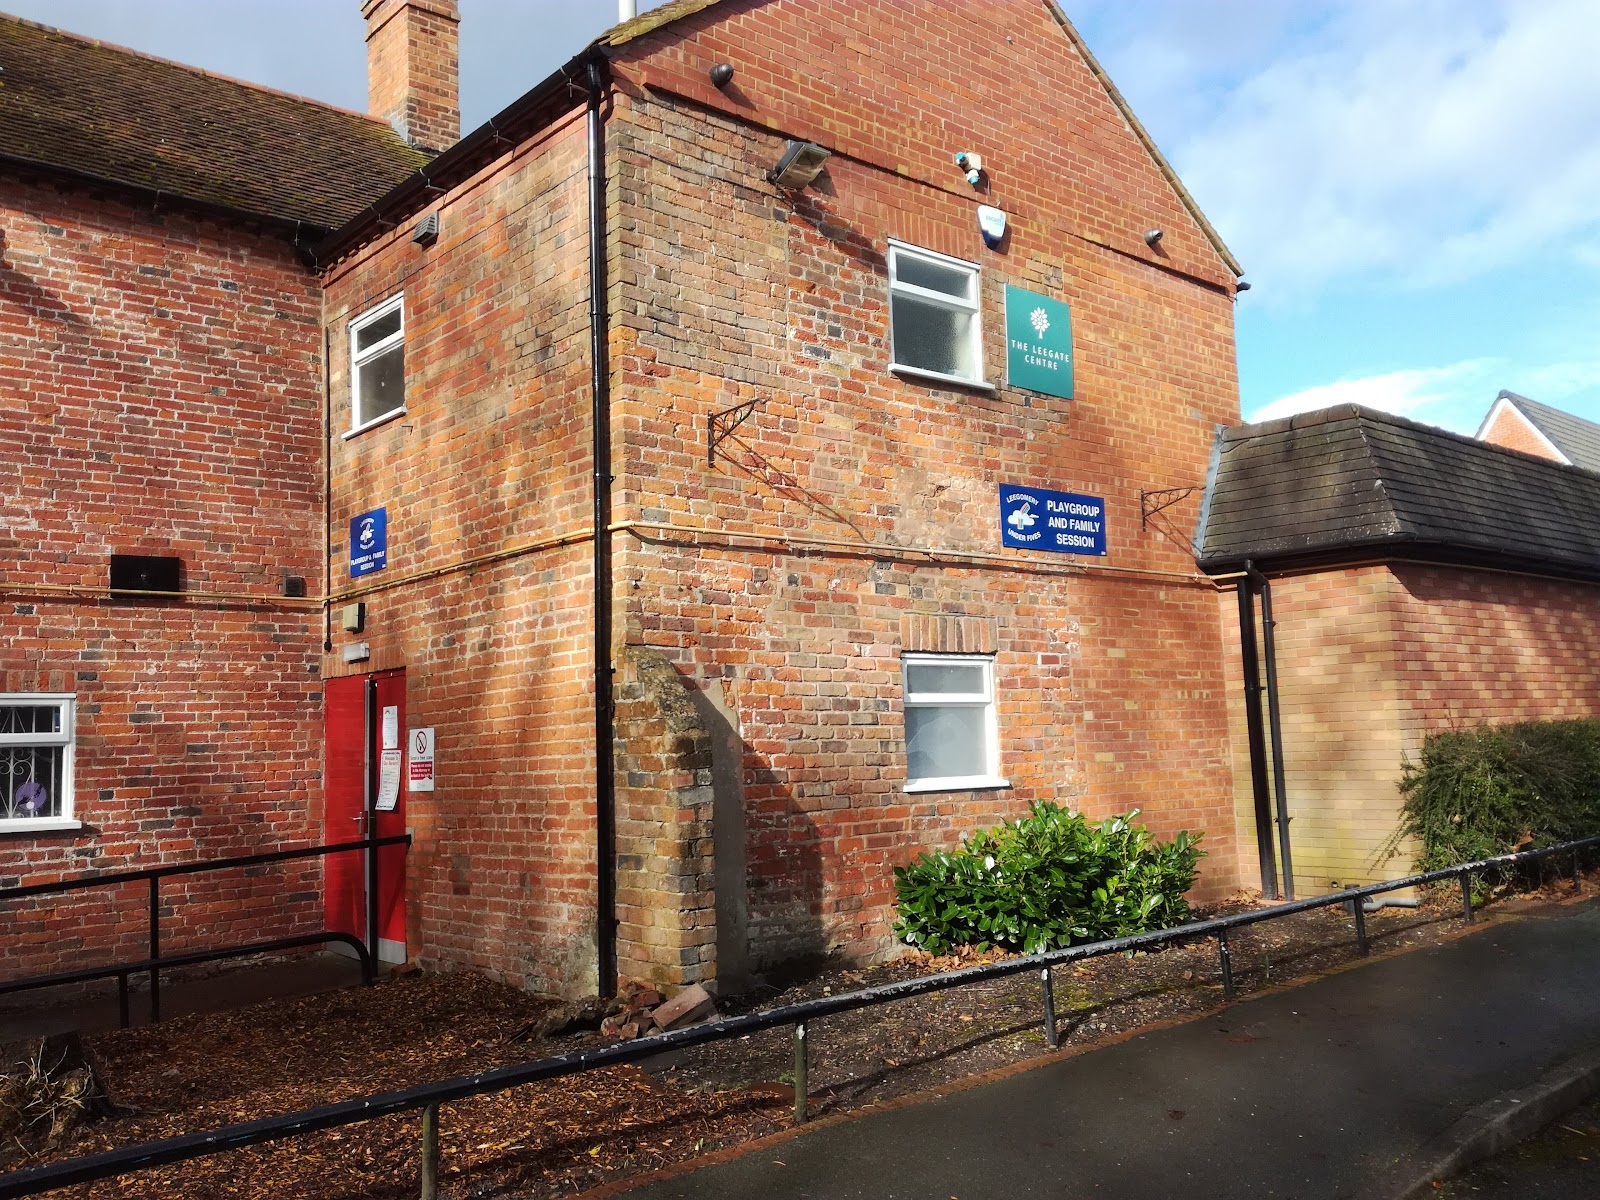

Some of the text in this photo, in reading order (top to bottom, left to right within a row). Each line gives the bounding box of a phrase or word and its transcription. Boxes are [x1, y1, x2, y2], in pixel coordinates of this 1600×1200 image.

[1011, 339, 1070, 362] THE LEEGATE
[1024, 354, 1058, 370] CENTRE
[1006, 494, 1039, 505] LEEGOMERY
[1047, 500, 1100, 517] PLAYGROUP
[1048, 516, 1100, 532] AND FAMILY
[1007, 528, 1041, 542] UNDER FIVES
[1056, 533, 1095, 548] SESSION
